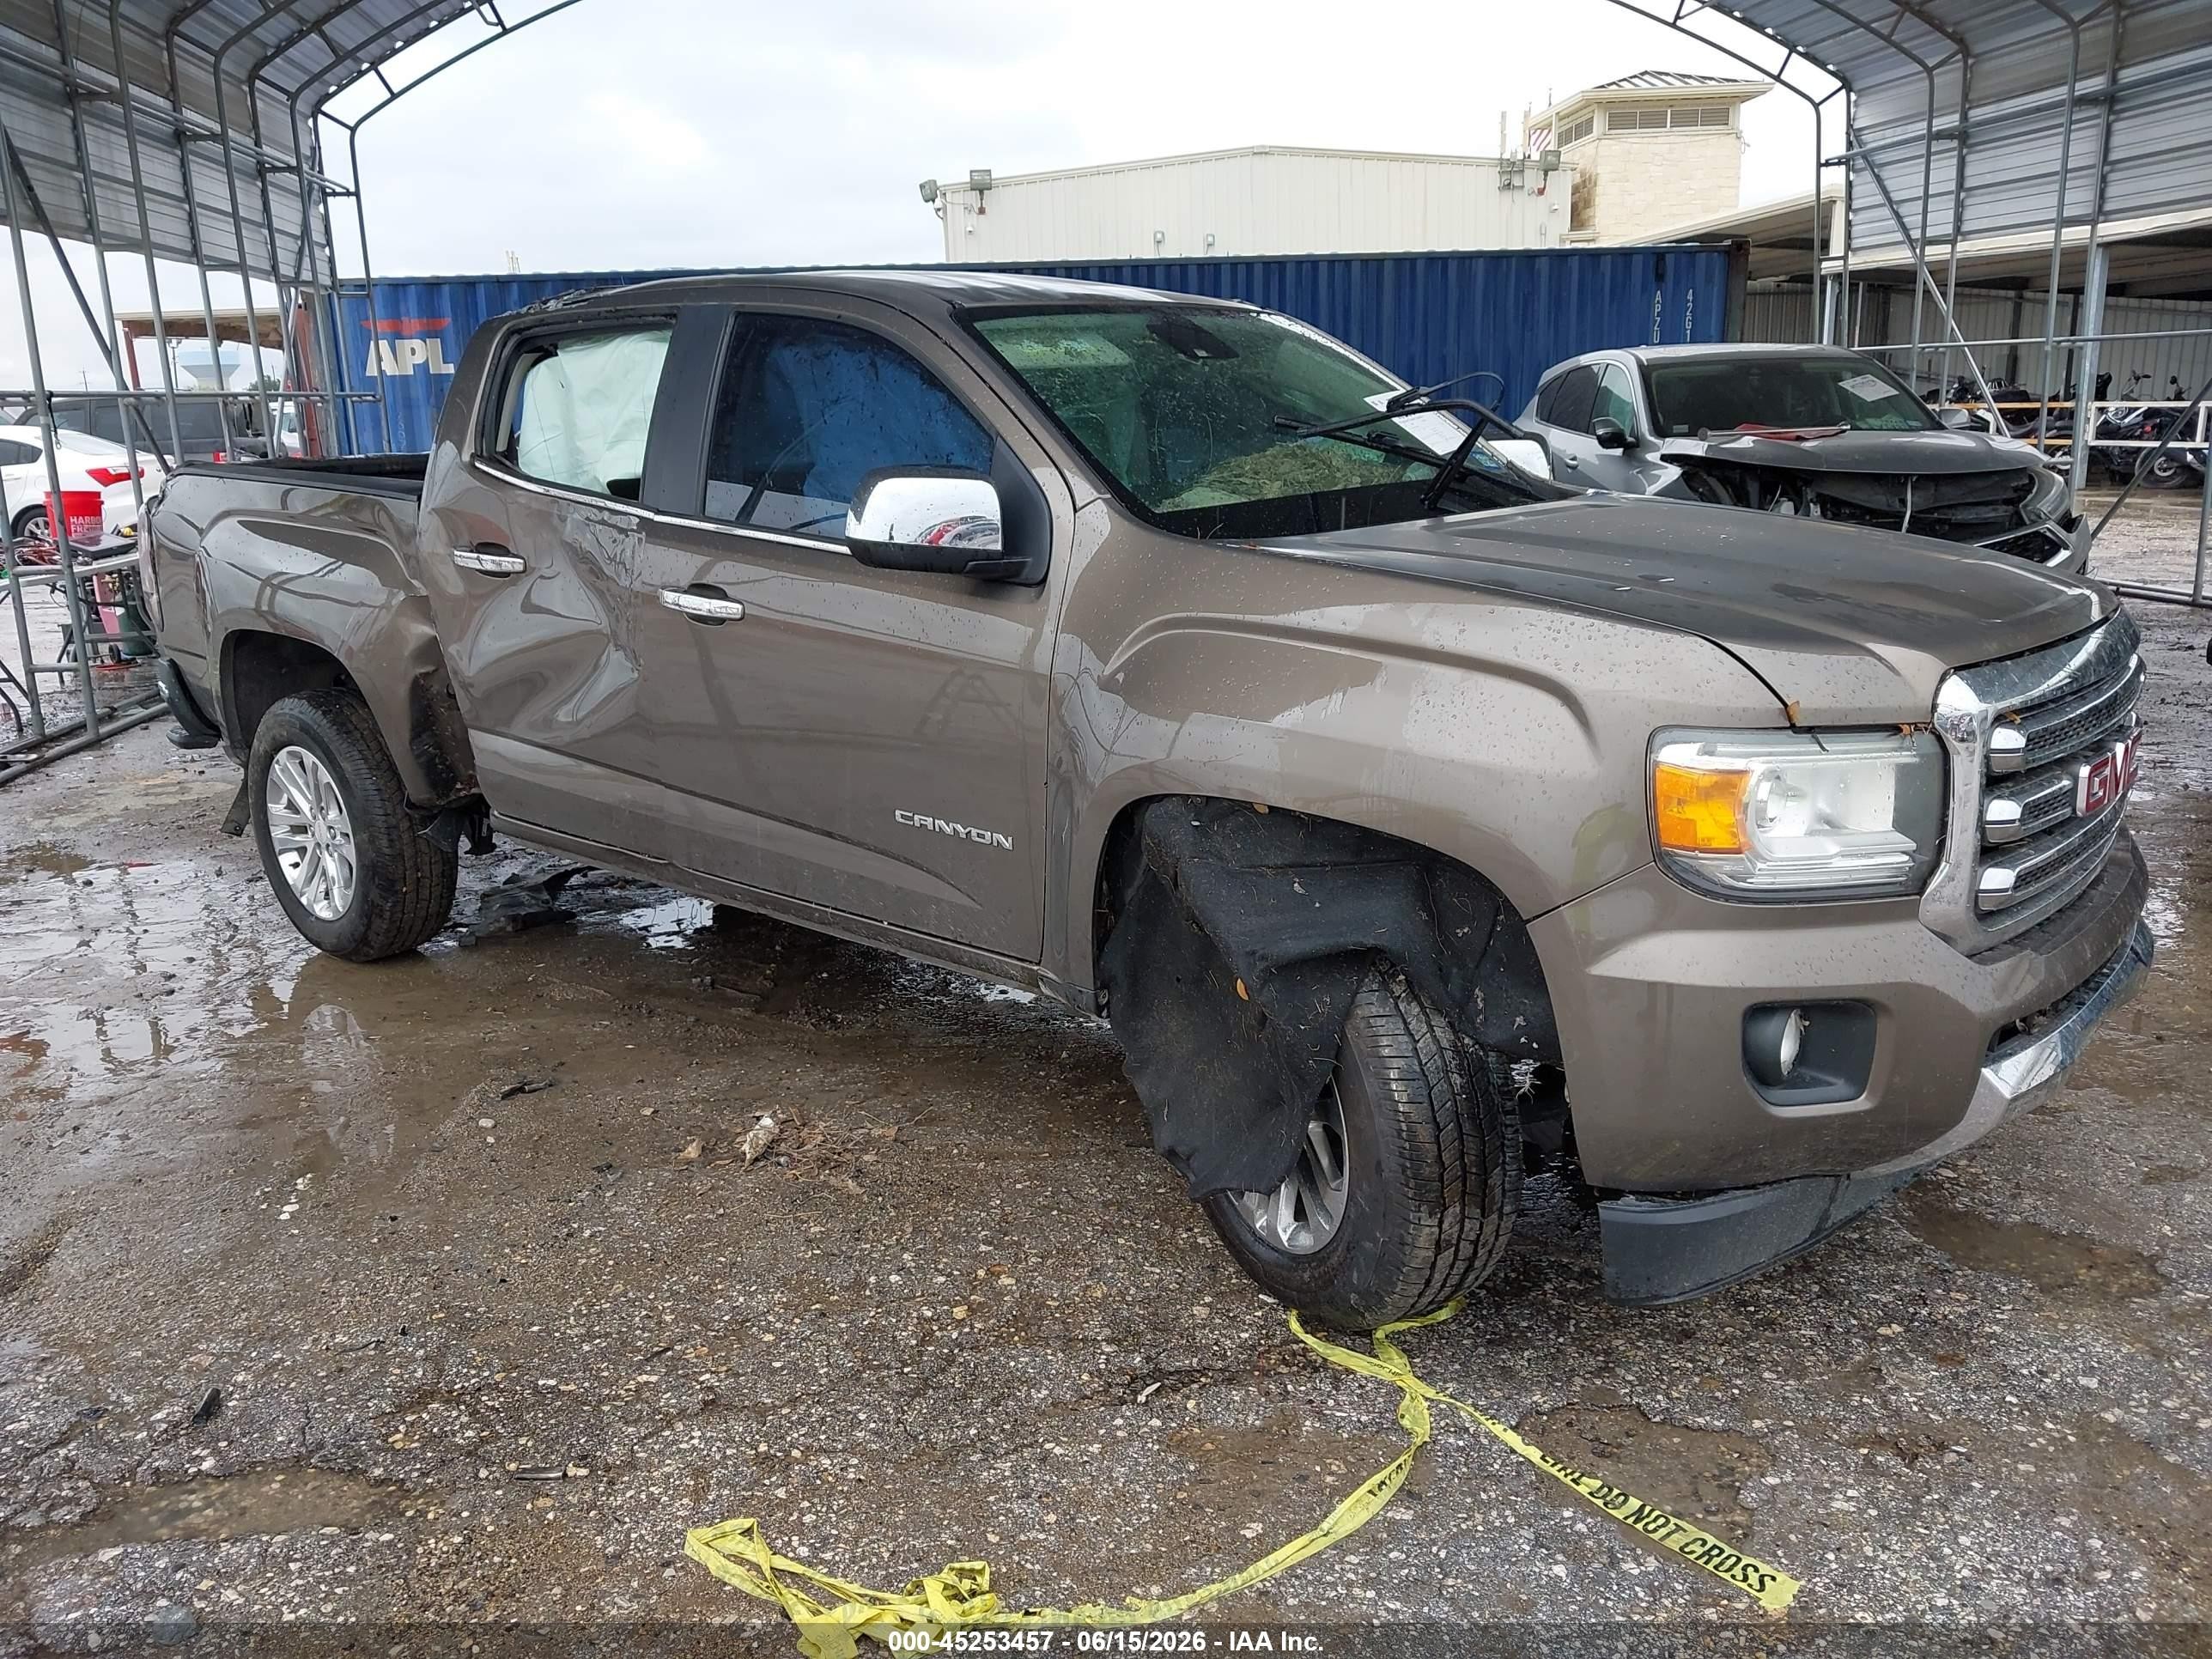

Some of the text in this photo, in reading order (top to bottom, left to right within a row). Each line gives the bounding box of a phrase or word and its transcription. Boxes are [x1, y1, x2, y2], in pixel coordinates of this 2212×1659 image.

[1653, 290, 1662, 343] APZU
[1685, 289, 1693, 343] 42G1
[365, 337, 455, 377] APL
[2075, 728, 2143, 817] GMC
[895, 809, 1014, 851] CANYON
[1587, 1483, 1630, 1510] DO
[1623, 1503, 1689, 1541] NOT
[1679, 1536, 1778, 1594] CROSS
